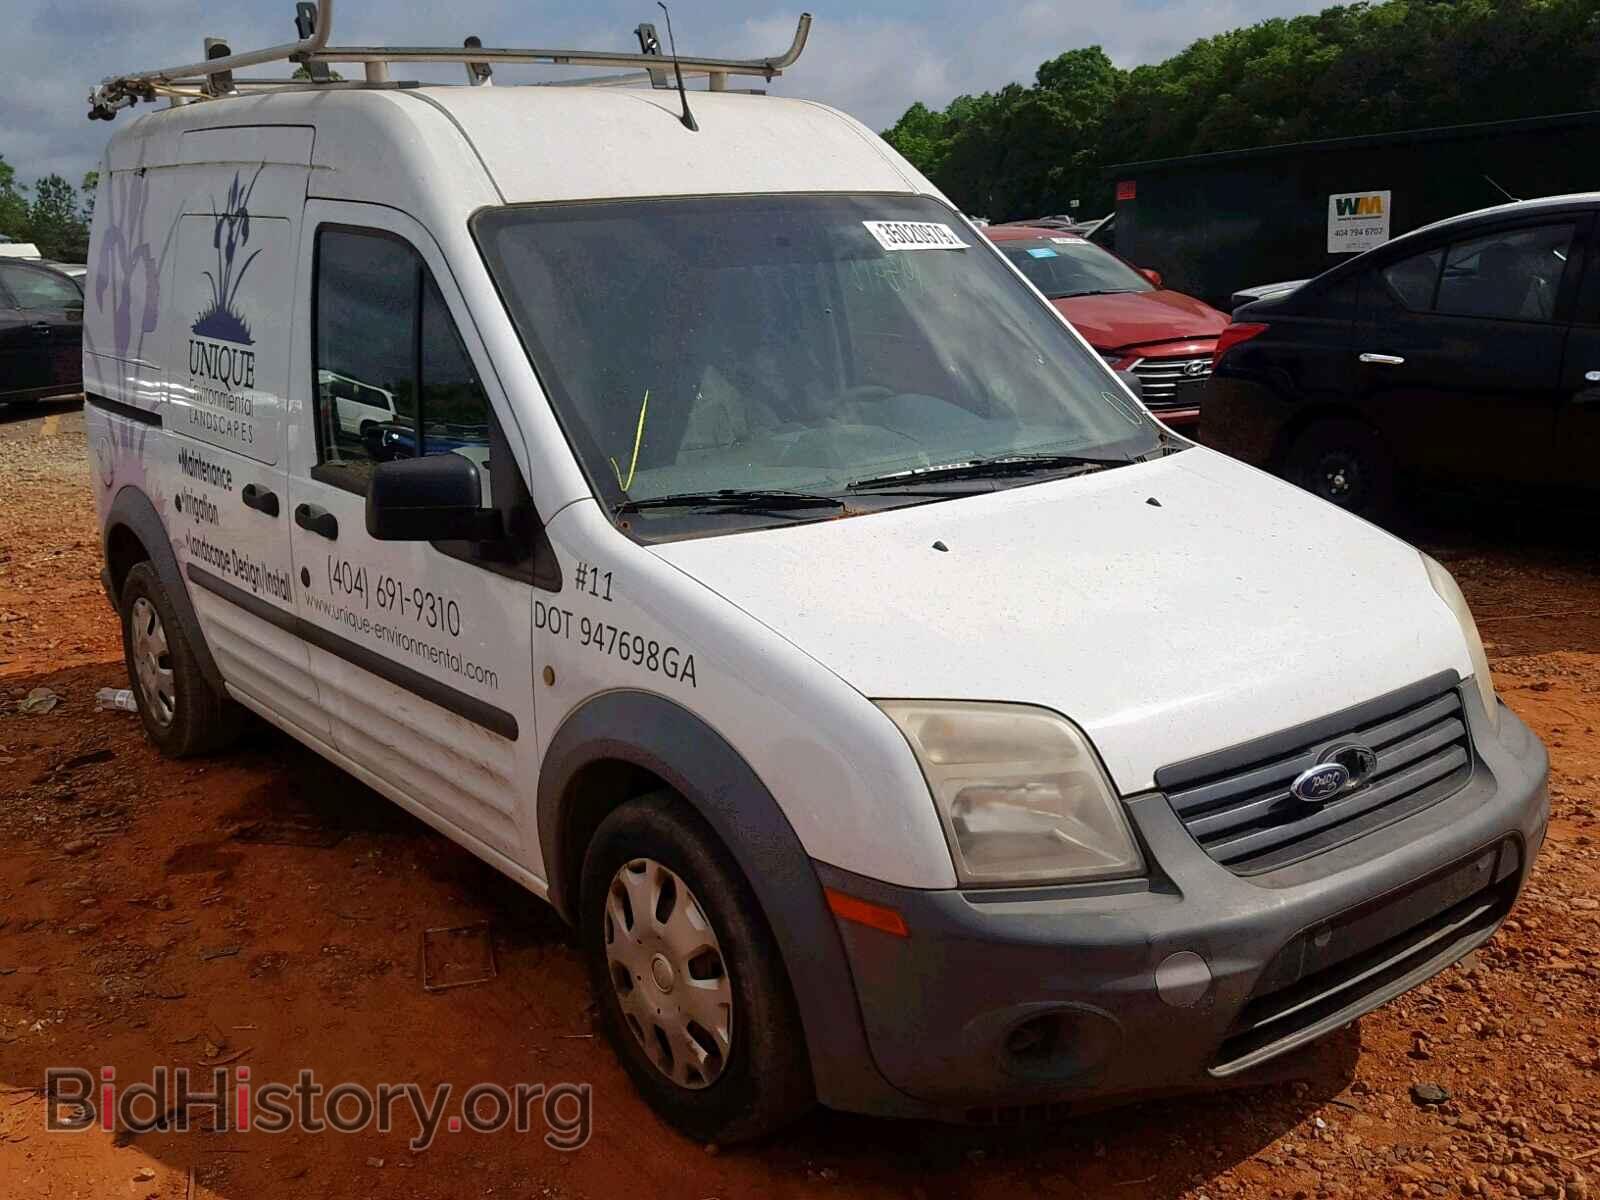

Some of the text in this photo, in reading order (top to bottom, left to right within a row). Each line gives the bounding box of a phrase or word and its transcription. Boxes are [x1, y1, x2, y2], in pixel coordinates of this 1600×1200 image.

[1335, 196, 1383, 216] WM
[189, 339, 255, 391] UNIQUE
[189, 407, 253, 443] LANDSCAPES
[180, 448, 232, 491] Maintenance
[187, 529, 231, 577] Landscape
[327, 554, 460, 637] (404) 691-9310
[576, 562, 613, 602] #11
[304, 591, 499, 688] www.unique-environmental.com
[534, 601, 697, 688] DOT 947698GA
